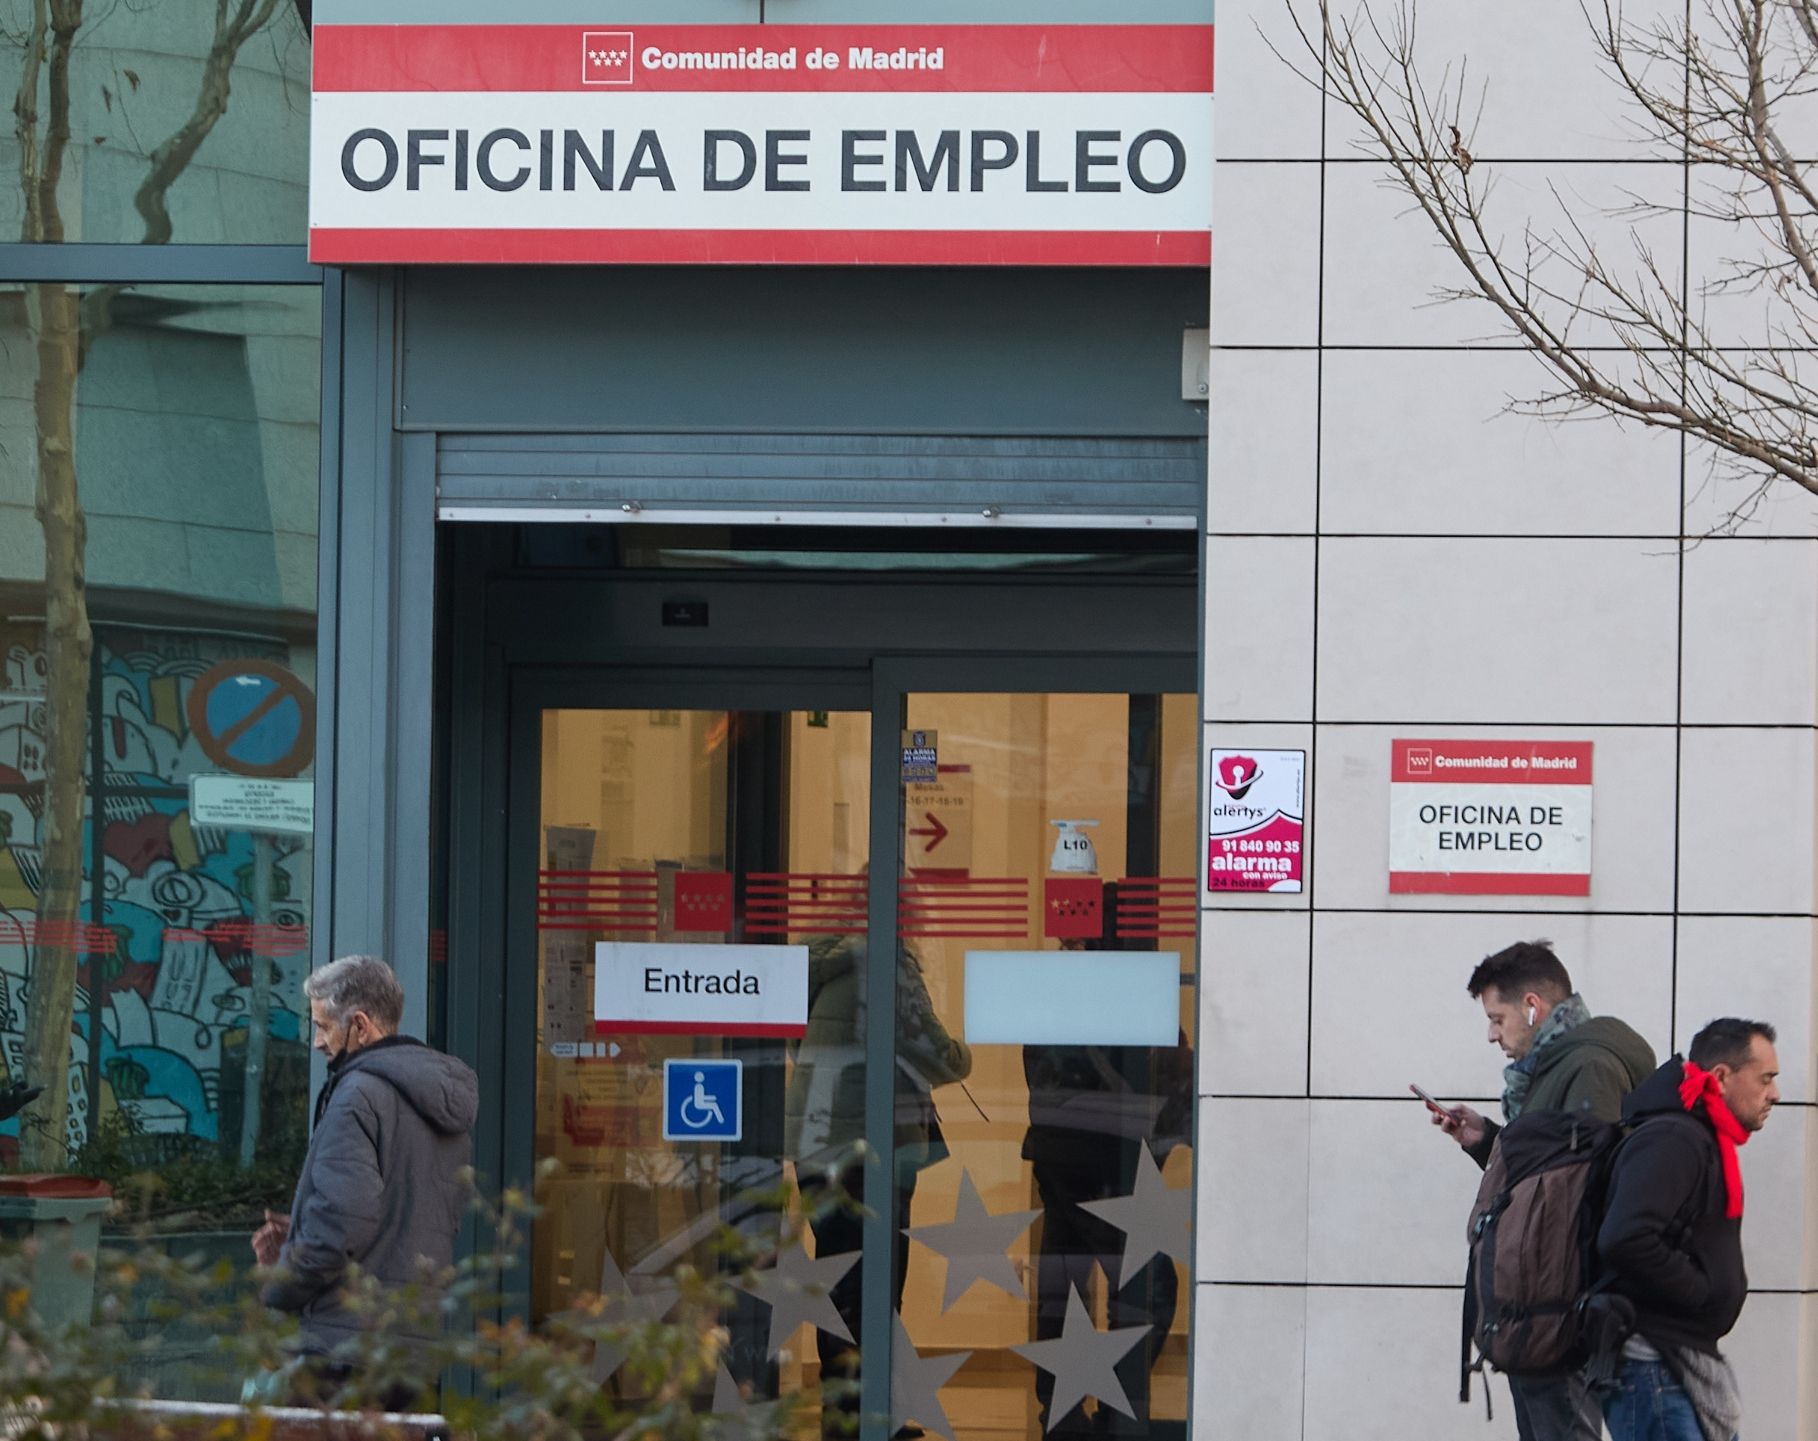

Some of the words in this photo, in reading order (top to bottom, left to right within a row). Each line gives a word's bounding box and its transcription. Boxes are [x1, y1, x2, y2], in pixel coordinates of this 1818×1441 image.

[641, 46, 797, 70] Comunidad
[805, 47, 840, 70] de
[848, 47, 944, 70] Madrid
[340, 127, 677, 193] OFICINA
[703, 129, 812, 193] DE
[840, 129, 1187, 195] EMPLEO
[1435, 755, 1508, 769] Comunidad
[1511, 756, 1528, 769] de
[1531, 756, 1577, 769] Madrid
[1213, 804, 1263, 820] alertys
[1419, 804, 1522, 825] OFICINA
[1530, 806, 1563, 826] DE
[1222, 840, 1237, 853] 91
[1266, 840, 1282, 853] 90
[1283, 841, 1300, 853] 35
[1438, 831, 1543, 852] EMPLEO
[1211, 853, 1292, 872] alarma
[1213, 878, 1227, 888] 24
[644, 967, 760, 995] Entrada
